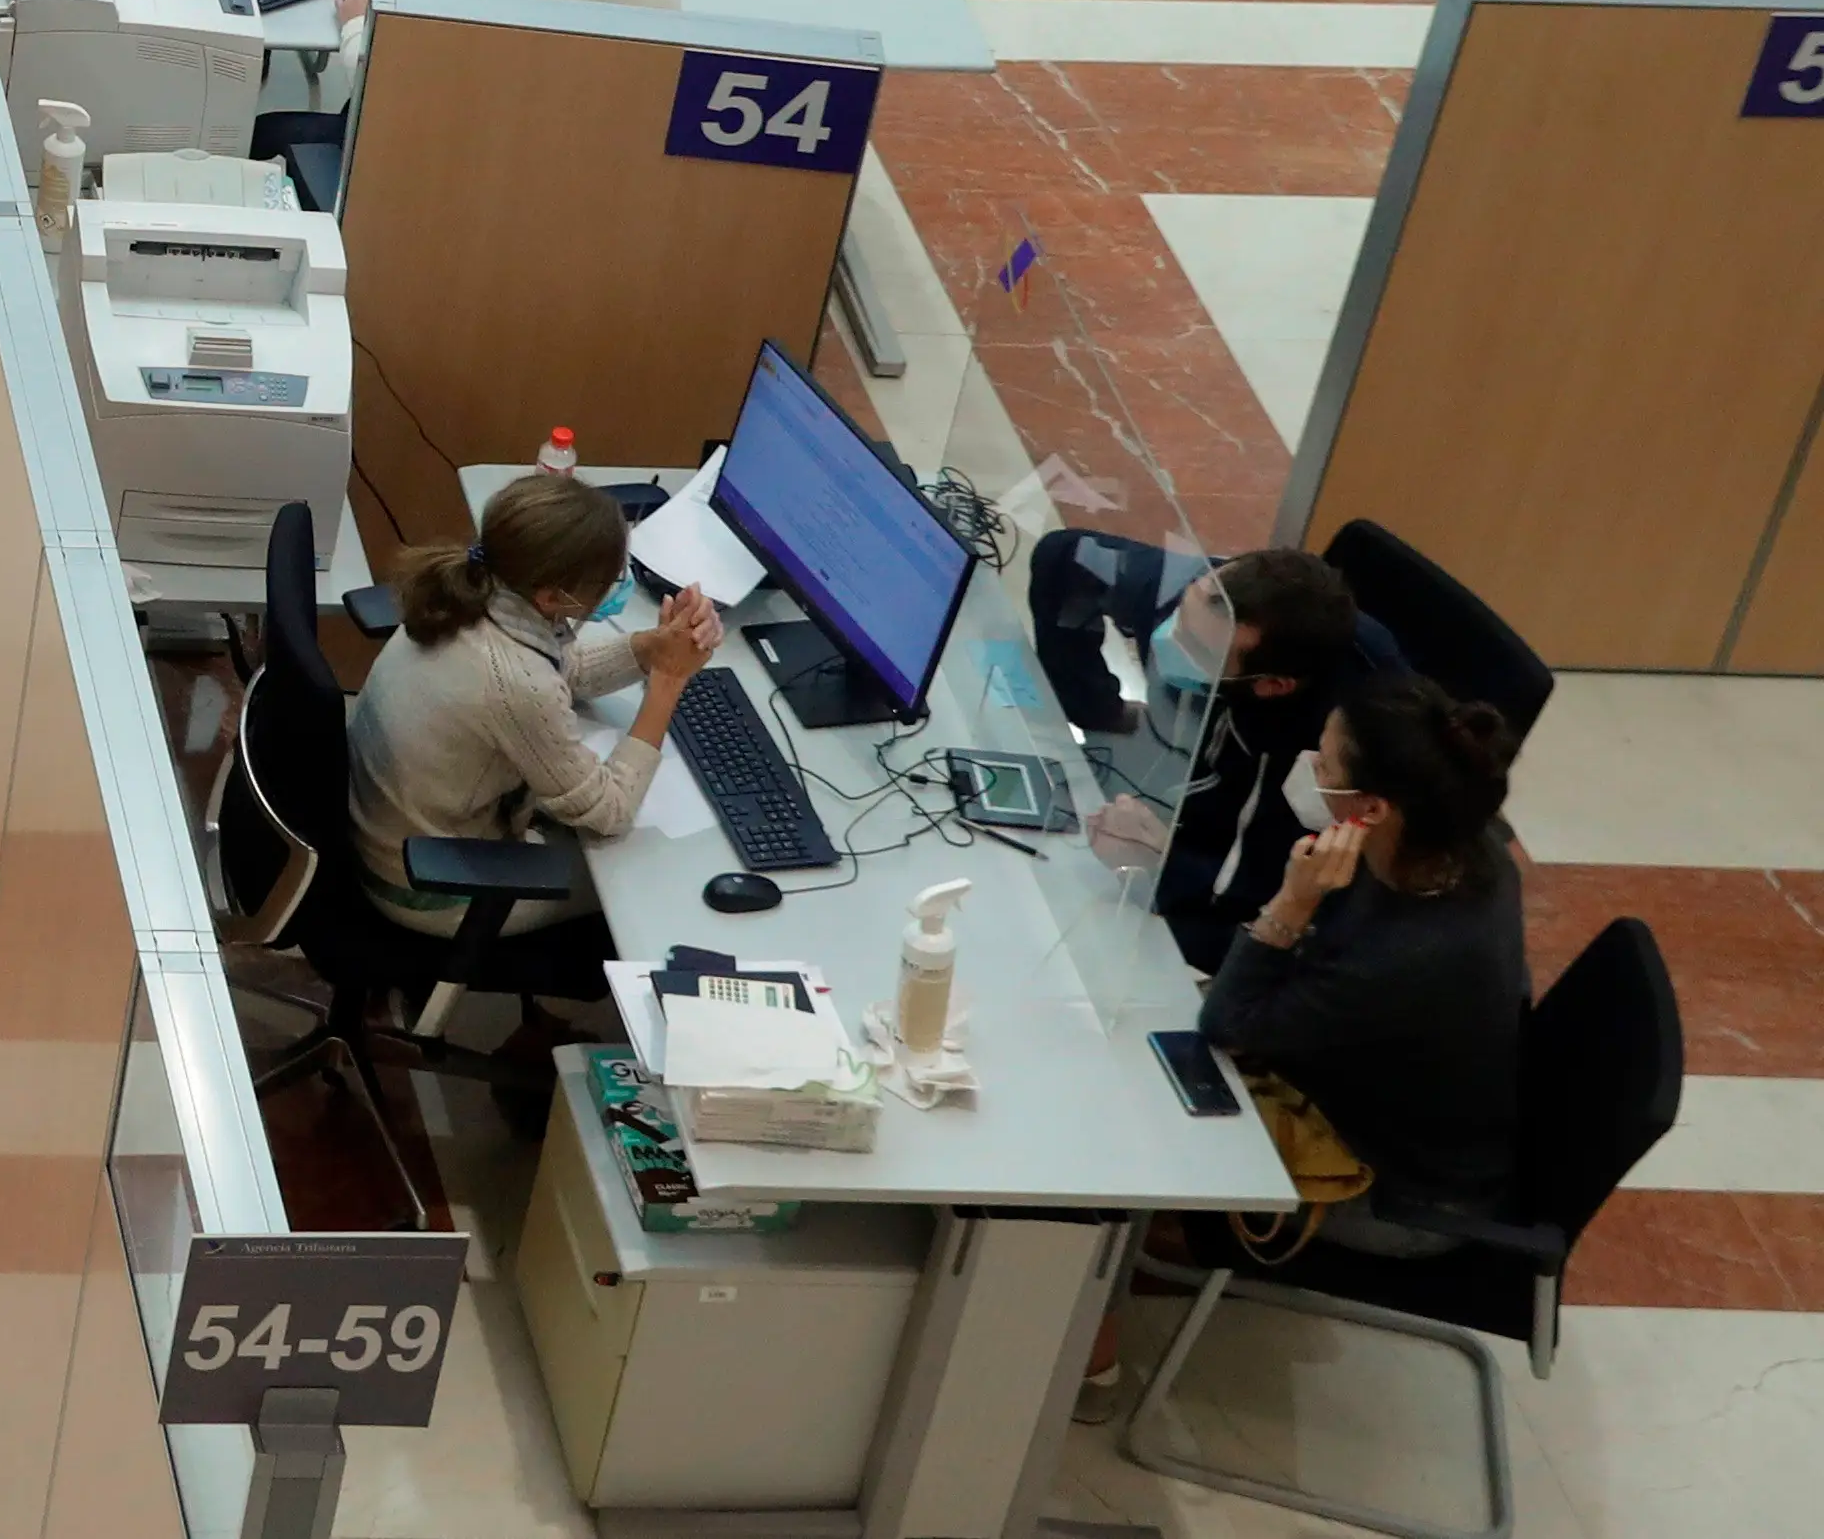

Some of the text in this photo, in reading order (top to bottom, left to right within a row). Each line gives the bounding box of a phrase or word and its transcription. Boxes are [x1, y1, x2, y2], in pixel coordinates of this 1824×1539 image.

[1779, 31, 1824, 104] 5
[700, 71, 832, 153] 54
[184, 1303, 441, 1372] 54-59
